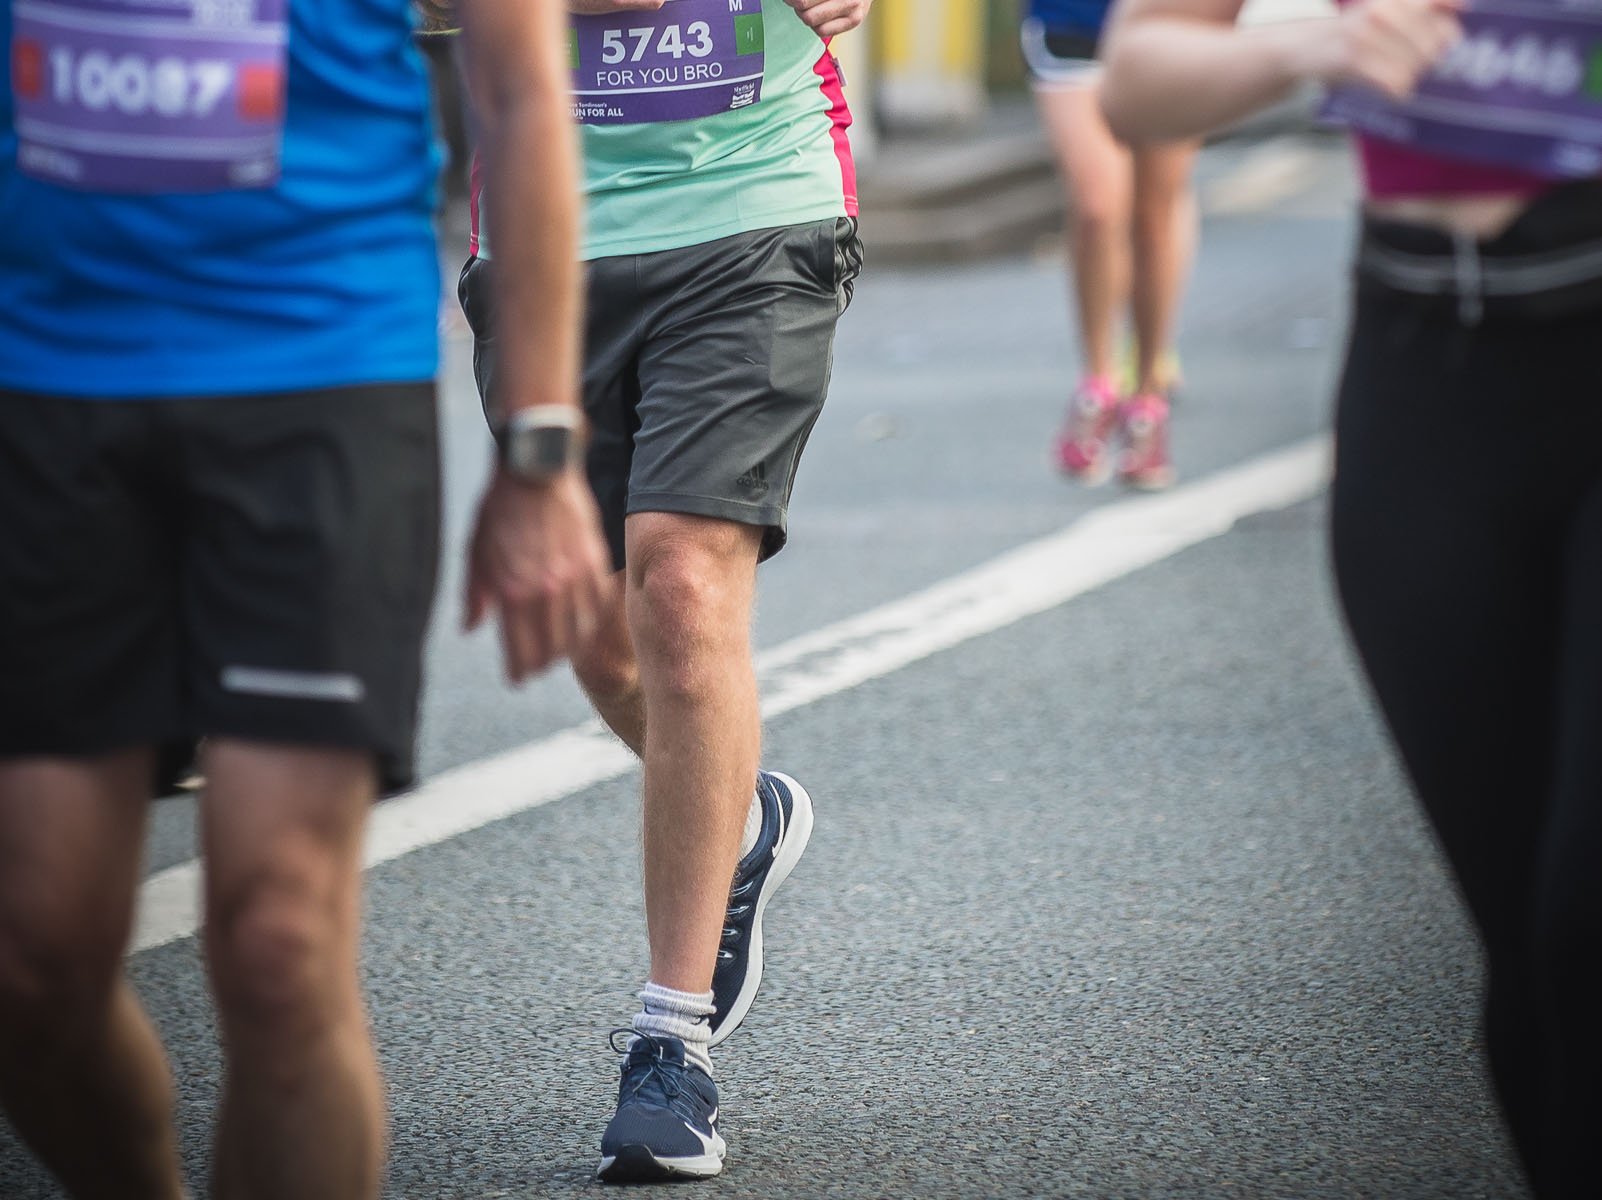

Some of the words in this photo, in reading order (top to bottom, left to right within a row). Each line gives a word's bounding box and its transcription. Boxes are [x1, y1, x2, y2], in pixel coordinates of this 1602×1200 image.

[602, 20, 714, 64] 5743
[596, 70, 635, 87] FOR
[638, 66, 679, 84] YOU
[683, 62, 723, 81] BRO
[587, 108, 606, 117] FOR
[607, 107, 624, 117] ALL
